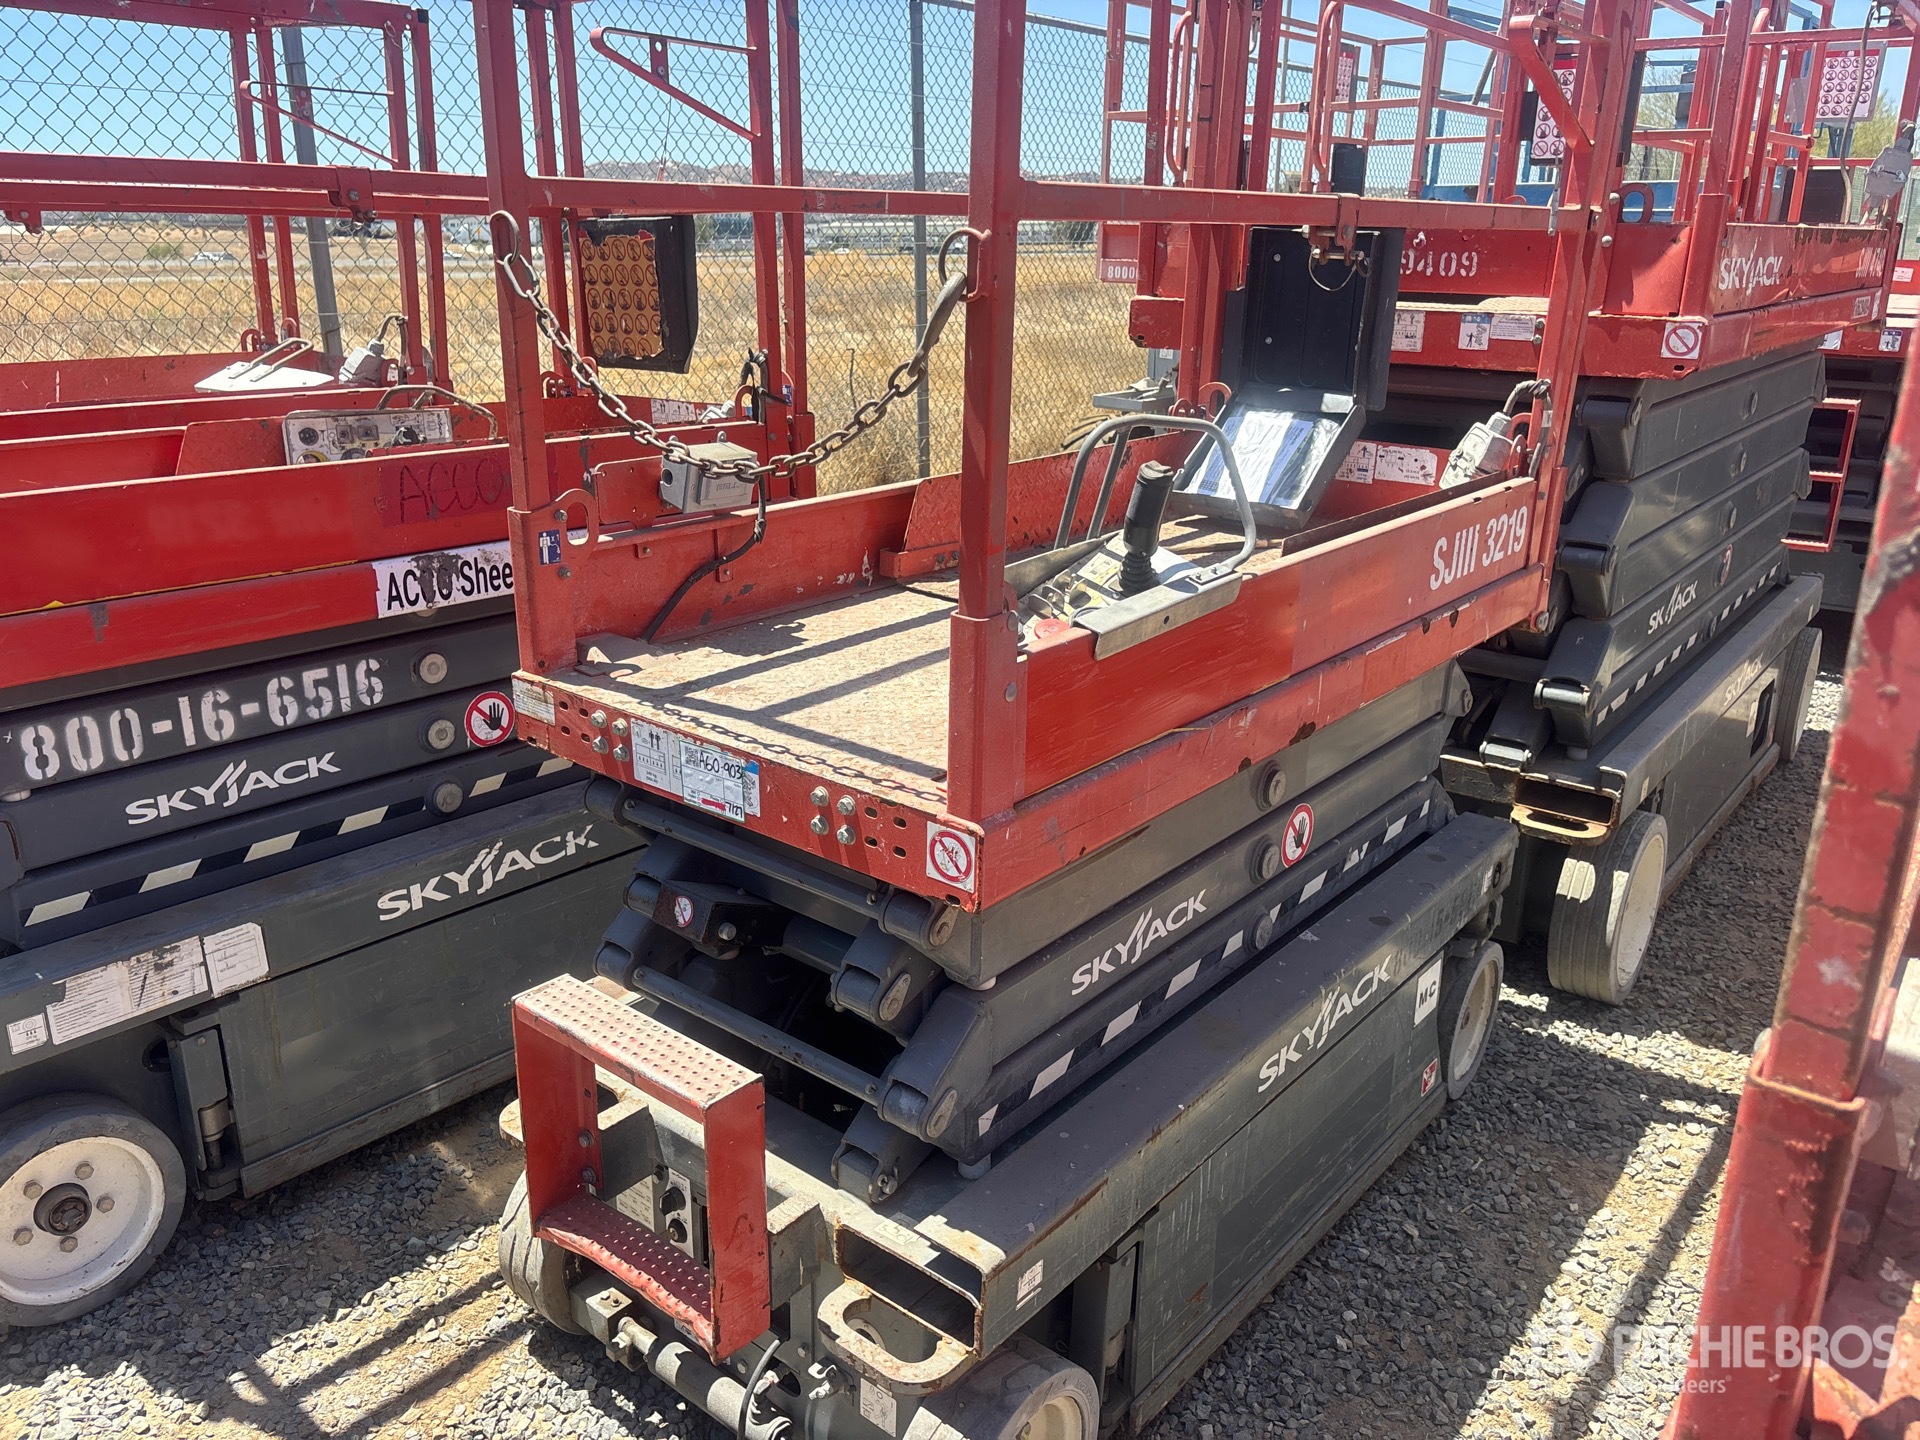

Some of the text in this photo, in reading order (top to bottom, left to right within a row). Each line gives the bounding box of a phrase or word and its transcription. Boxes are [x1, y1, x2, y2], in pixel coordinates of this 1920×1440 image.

[1107, 265, 1135, 279] 8000
[1718, 238, 1783, 295] SKYJACK
[1482, 505, 1529, 568] 3219
[20, 658, 386, 780] 800-16-6516
[124, 752, 342, 826] SKYJACK
[699, 751, 742, 780] A60-903
[377, 824, 599, 922] SKYJACK
[1070, 888, 1208, 997] SKYJACK
[1257, 954, 1392, 1094] SKYJACK
[1417, 981, 1437, 1009] MC
